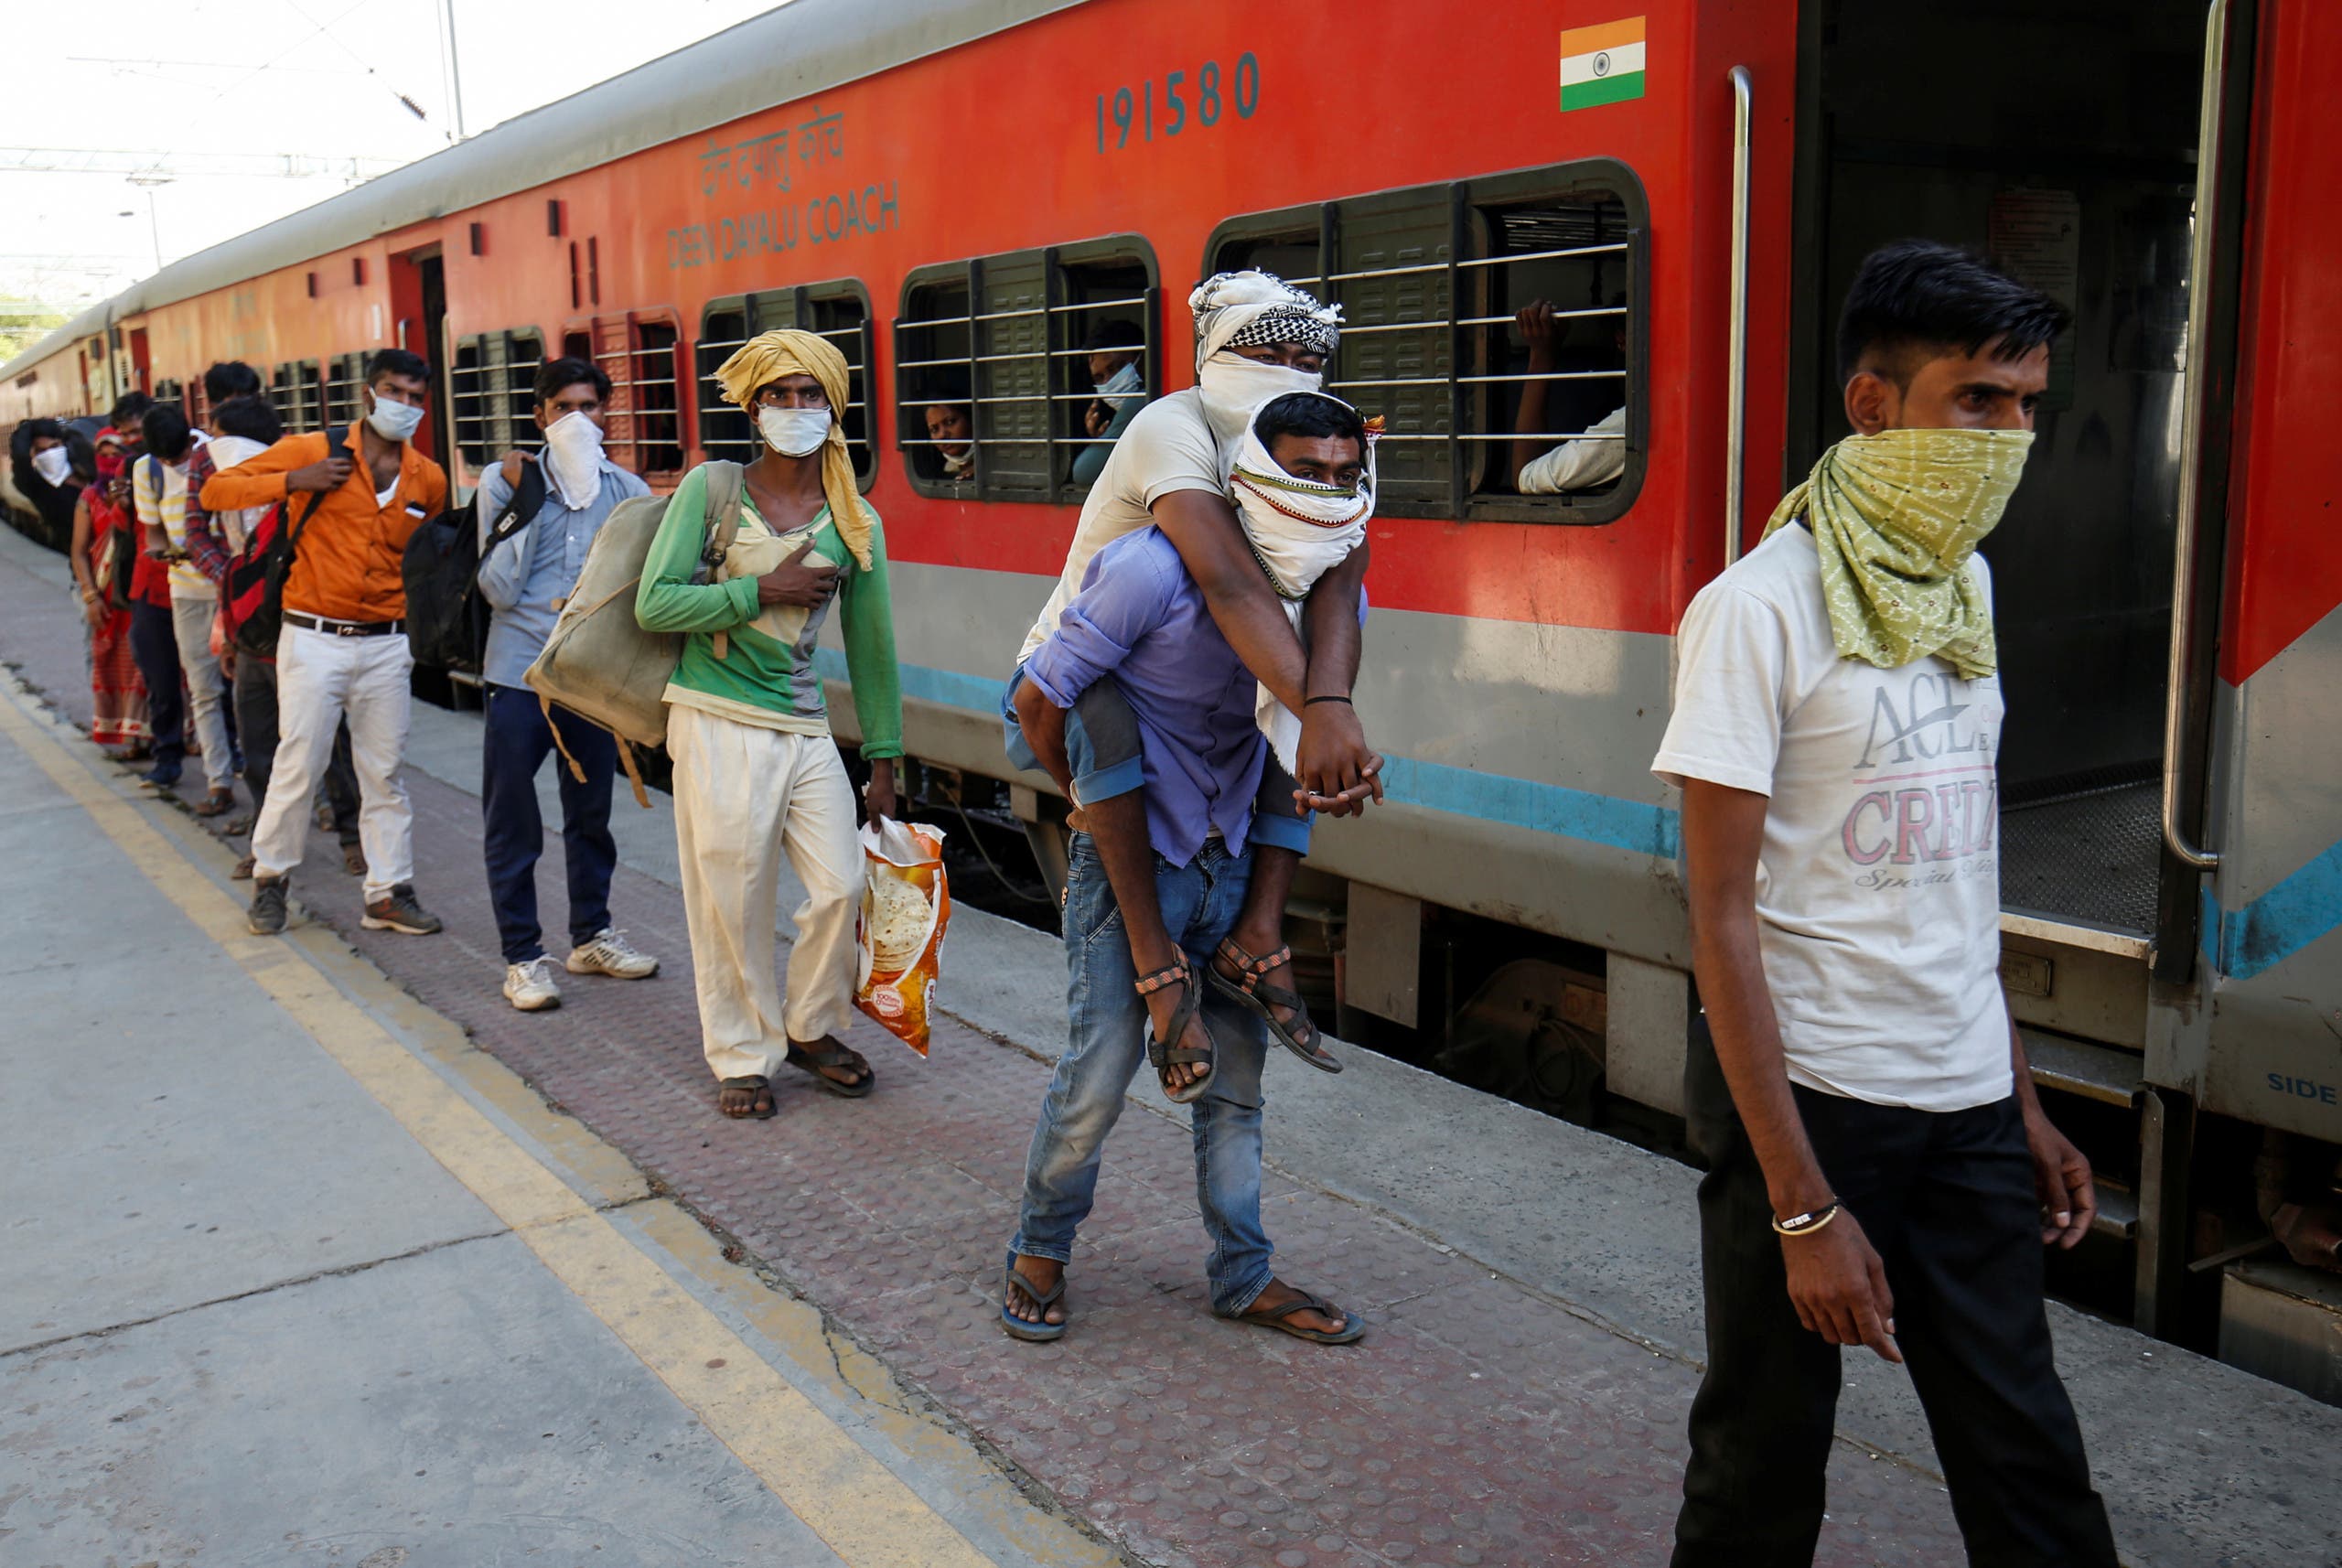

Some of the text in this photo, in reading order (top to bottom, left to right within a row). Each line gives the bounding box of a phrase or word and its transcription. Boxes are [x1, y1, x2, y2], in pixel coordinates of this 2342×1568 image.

[1096, 50, 1260, 155] 191580
[736, 129, 791, 193] दयालु
[797, 104, 844, 170] कोच
[666, 178, 900, 270] DEEN DAYALU COACH
[1854, 869, 1955, 892] Special
[2267, 1073, 2337, 1105] SIDE
